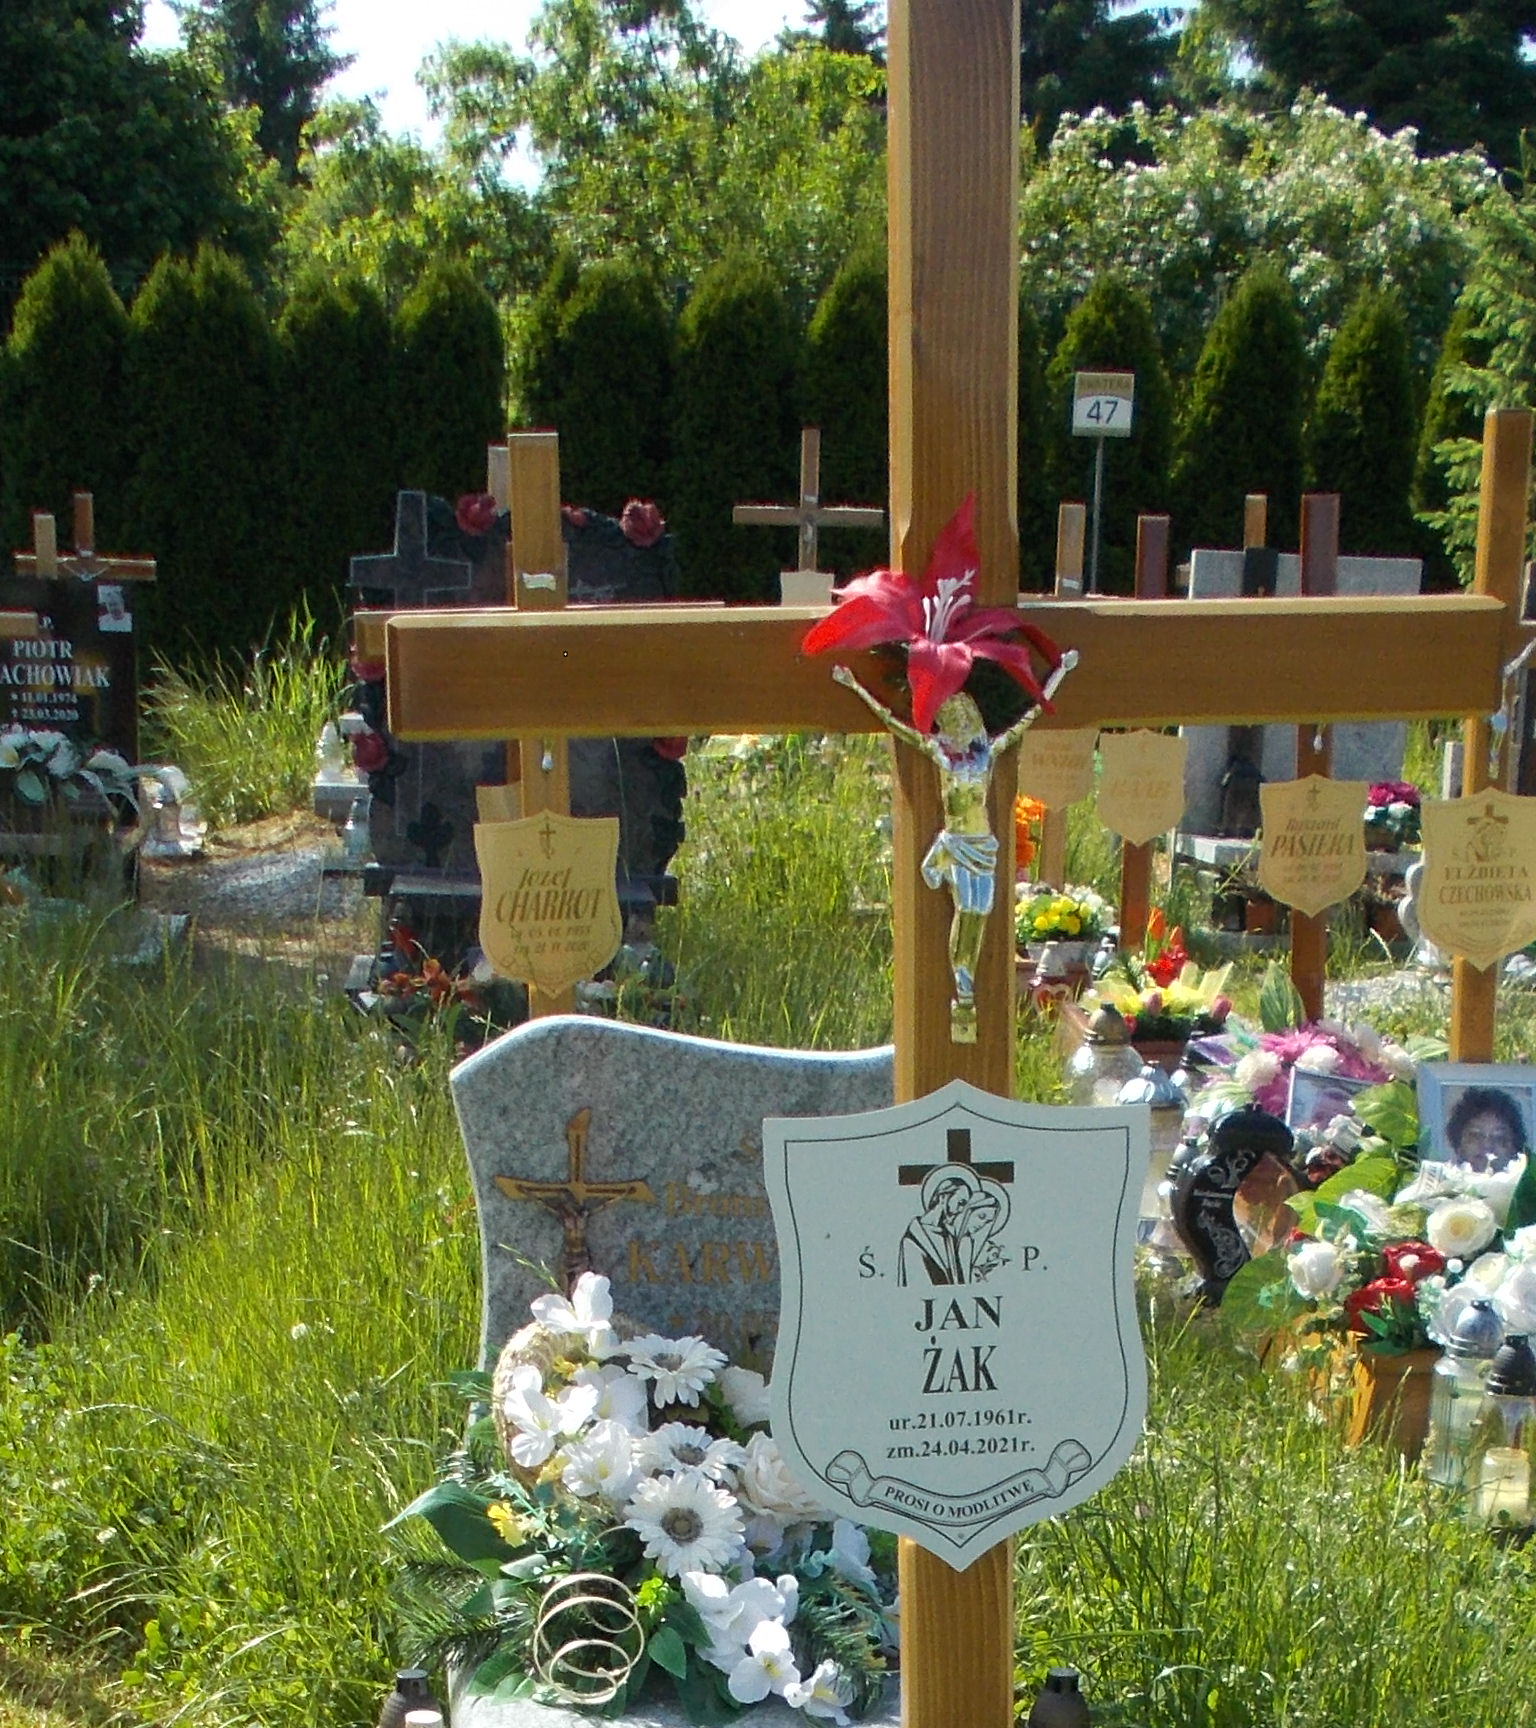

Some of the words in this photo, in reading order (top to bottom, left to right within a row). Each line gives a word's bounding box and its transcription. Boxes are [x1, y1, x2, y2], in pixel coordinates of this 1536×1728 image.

[1086, 400, 1119, 425] 47
[13, 640, 73, 658] PIOTR
[858, 1245, 885, 1279] Ś.
[1021, 1245, 1048, 1272] P.
[914, 1296, 1004, 1332] JAN
[922, 1335, 998, 1394] ŻAK
[889, 1408, 1033, 1431] ur.21.07.1961r.
[886, 1436, 1035, 1459] zm.24.04.2021r.
[884, 1485, 930, 1513] PROSI
[932, 1502, 946, 1517] O
[947, 1478, 1037, 1519] MODLITWĘ
